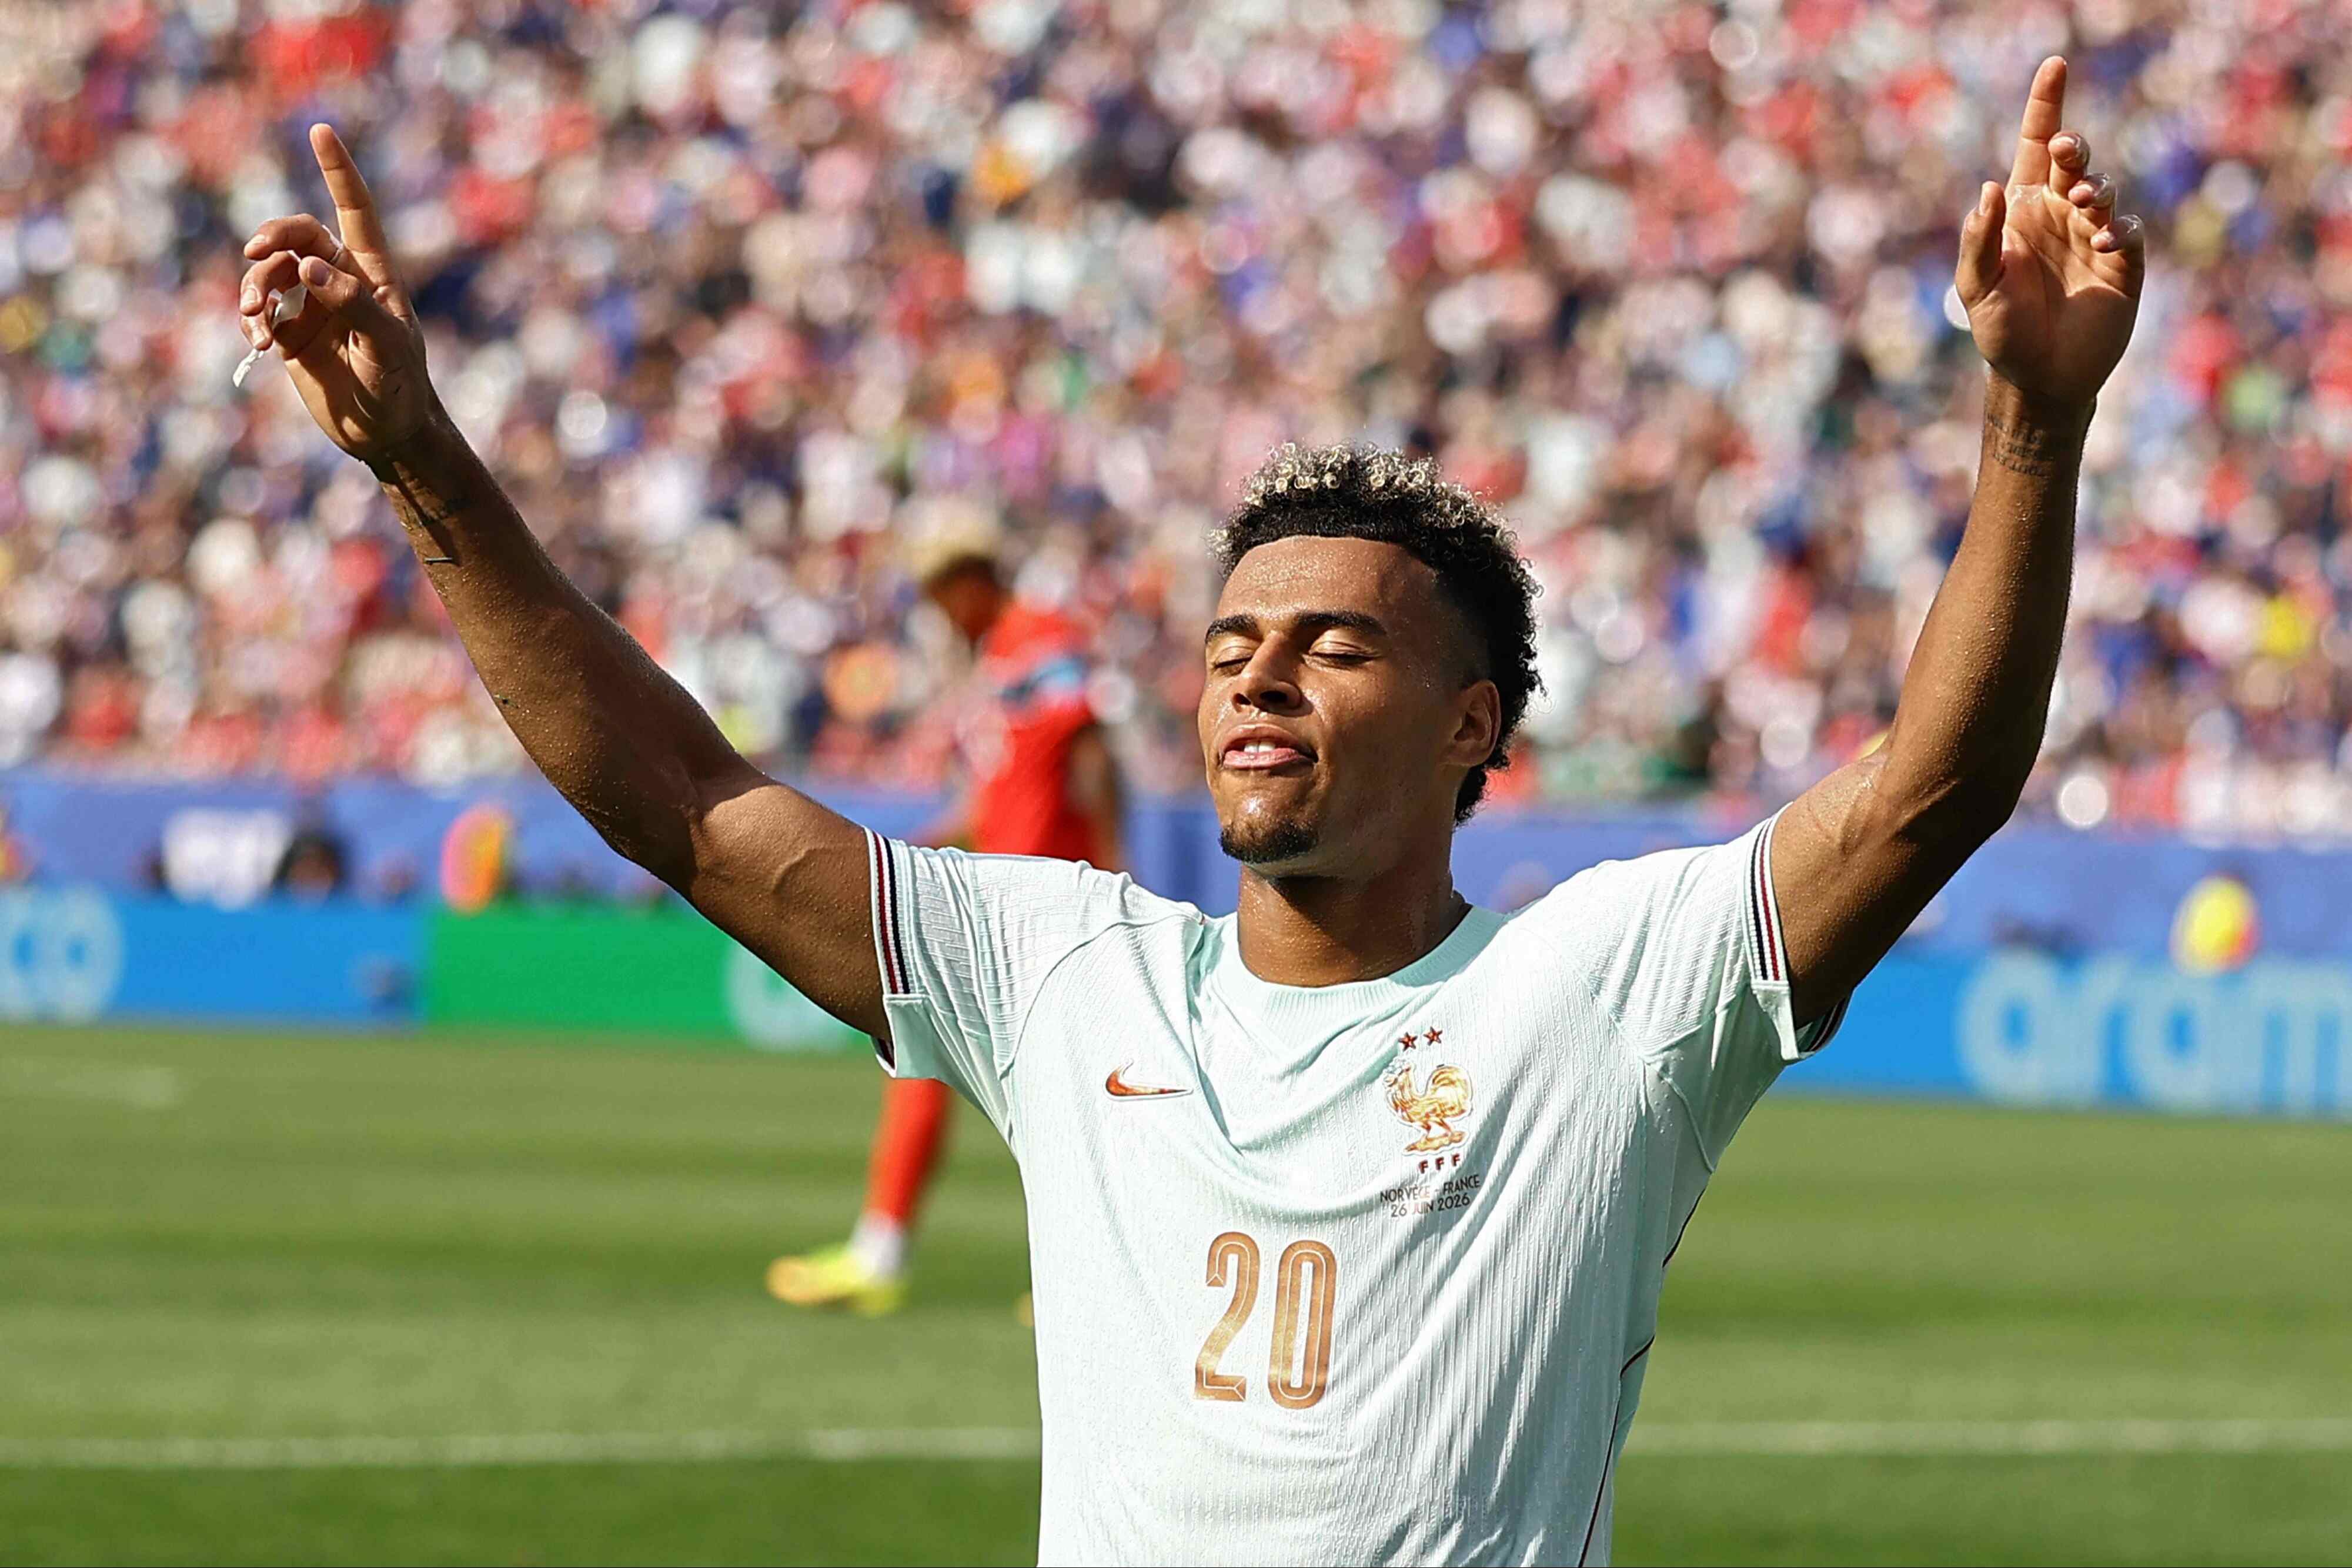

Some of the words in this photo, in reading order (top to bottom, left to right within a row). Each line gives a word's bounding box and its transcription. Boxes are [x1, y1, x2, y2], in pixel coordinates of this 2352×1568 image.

[1442, 1175, 1481, 1195] FRANCE
[1391, 1203, 1407, 1217] 26
[1413, 1200, 1434, 1215] JUIN
[1437, 1193, 1470, 1211] 2026
[1192, 1232, 1337, 1409] 20
